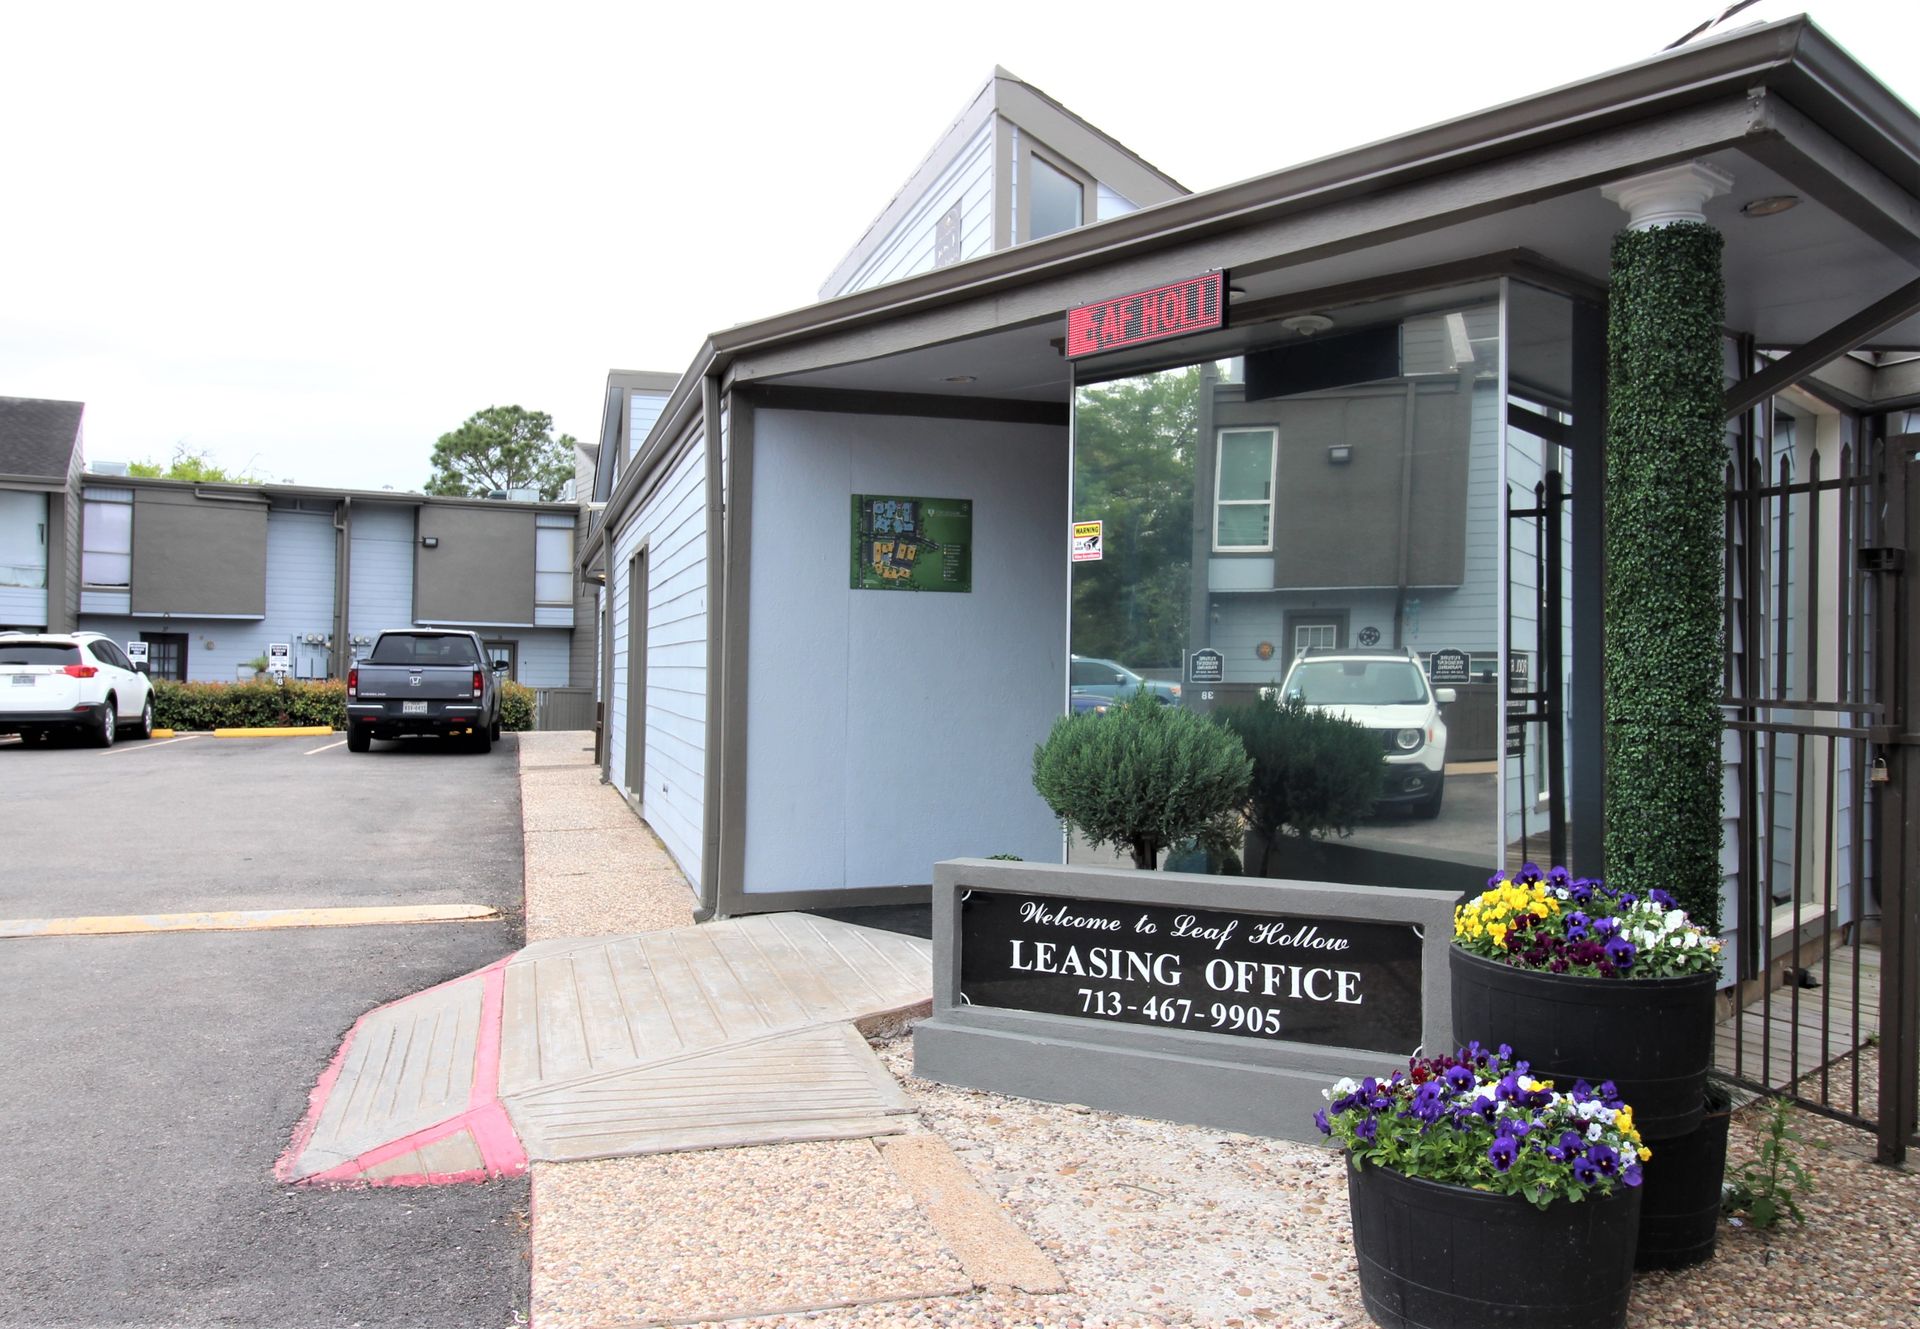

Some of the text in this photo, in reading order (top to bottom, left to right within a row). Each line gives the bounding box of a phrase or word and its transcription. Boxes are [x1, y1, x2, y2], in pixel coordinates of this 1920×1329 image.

[1142, 282, 1216, 334] HOLL
[1075, 526, 1099, 534] WARNING
[1019, 901, 1350, 951] Welcome to Leaf Hollow
[1009, 939, 1363, 1005] LEASING OFFICE
[1078, 988, 1281, 1034] 713-467-9905
